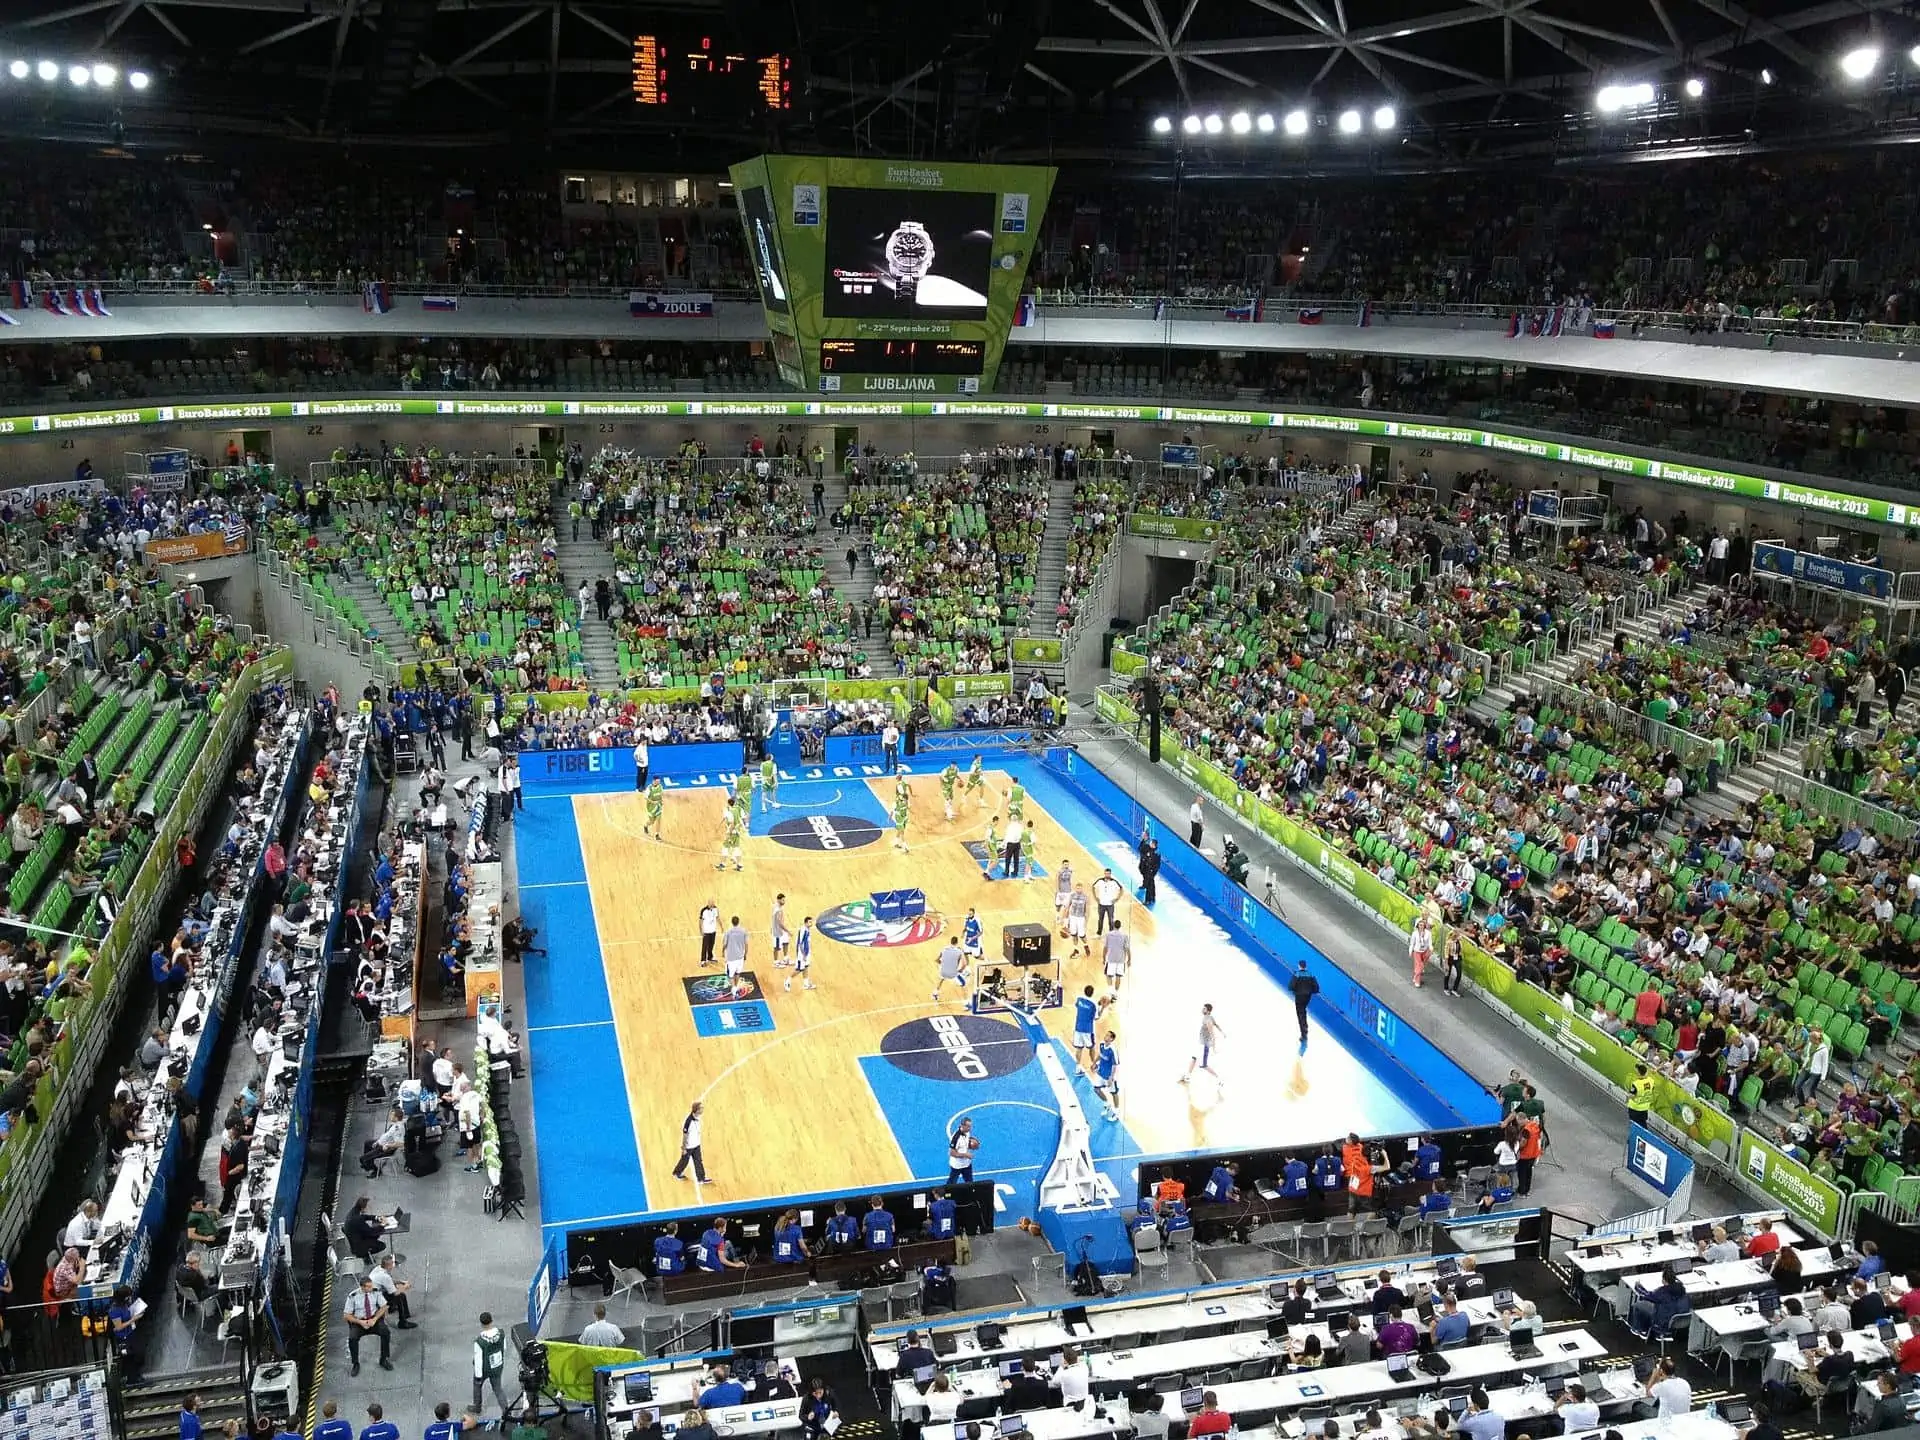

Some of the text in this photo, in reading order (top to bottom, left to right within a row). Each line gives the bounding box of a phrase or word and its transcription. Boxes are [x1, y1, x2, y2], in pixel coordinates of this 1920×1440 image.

[887, 167, 941, 178] EuroBasket
[663, 303, 702, 313] ZDOLE
[889, 324, 930, 334] September
[864, 377, 936, 391] LJUBLJANA
[178, 406, 271, 419] EuroBasket 2013
[313, 402, 402, 414] EuroBasket 2013
[457, 403, 546, 413] EuroBasket 2013
[583, 404, 668, 414] EuroBasket 2013
[706, 404, 788, 414] EuroBasket 2013
[824, 404, 902, 414] EuroBasket 2013
[950, 404, 1028, 415] EuroBasket 2013
[1061, 406, 1141, 419] EuroBasket 2013
[54, 413, 140, 429] EuroBasket 2013
[1175, 410, 1251, 424] EuroBasket 2013
[307, 425, 324, 436] 22
[600, 423, 614, 433] 23
[777, 423, 792, 433] 24
[1035, 424, 1050, 434] 25
[1287, 416, 1360, 432] EuroBasket 2013
[1401, 426, 1473, 442] EuroBasket 2013
[1663, 467, 1735, 490] EuroBasket 2013
[1783, 488, 1869, 515] EuroBasket 2013
[1808, 561, 1844, 577] EuroBasket
[1829, 574, 1845, 585] 2013
[546, 751, 614, 775] FIBAEU
[806, 815, 845, 849] BEKO
[1350, 986, 1397, 1048] FIBAEU
[928, 1014, 989, 1079] BEKO
[1774, 1162, 1825, 1204] EuroBasket
[1803, 1193, 1826, 1216] 2013
